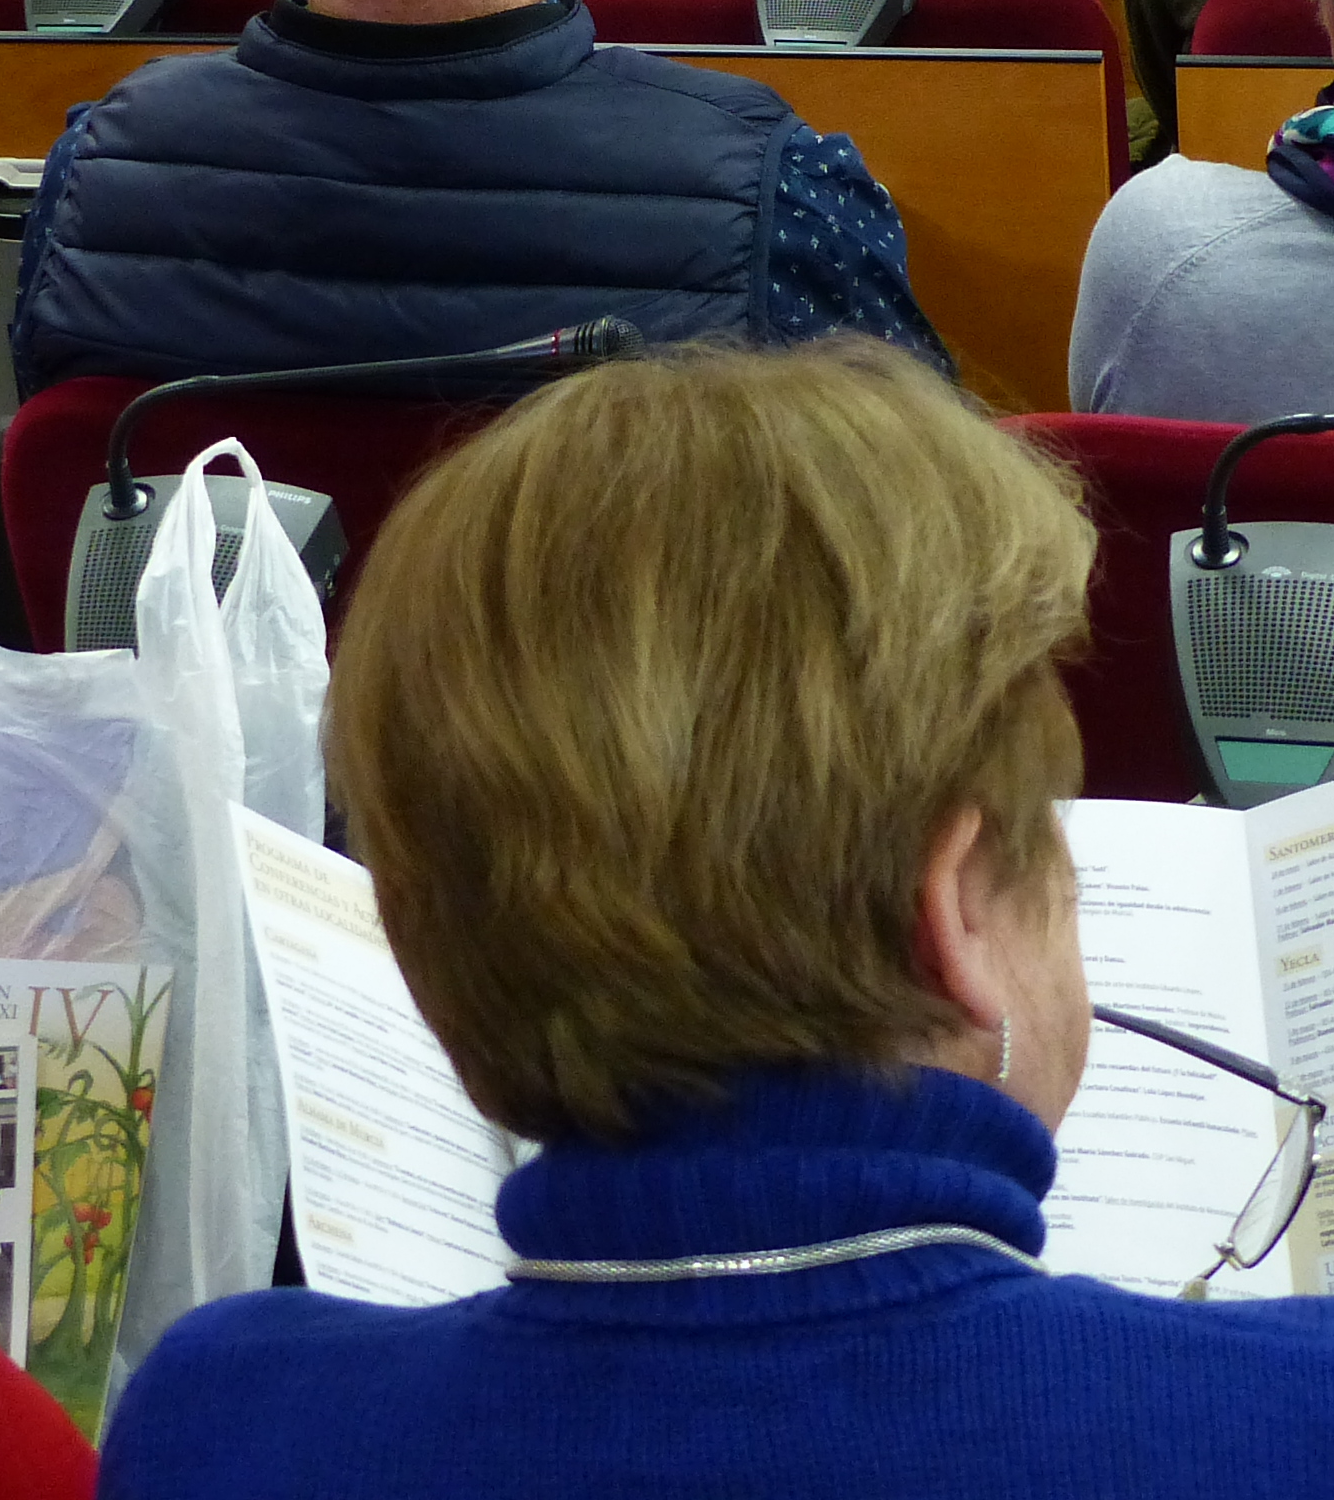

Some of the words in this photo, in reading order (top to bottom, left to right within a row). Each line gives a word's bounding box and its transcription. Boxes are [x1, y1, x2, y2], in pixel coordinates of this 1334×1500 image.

[267, 489, 312, 505] PHILIPS
[1280, 953, 1321, 972] YECLA
[28, 985, 114, 1049] IV
